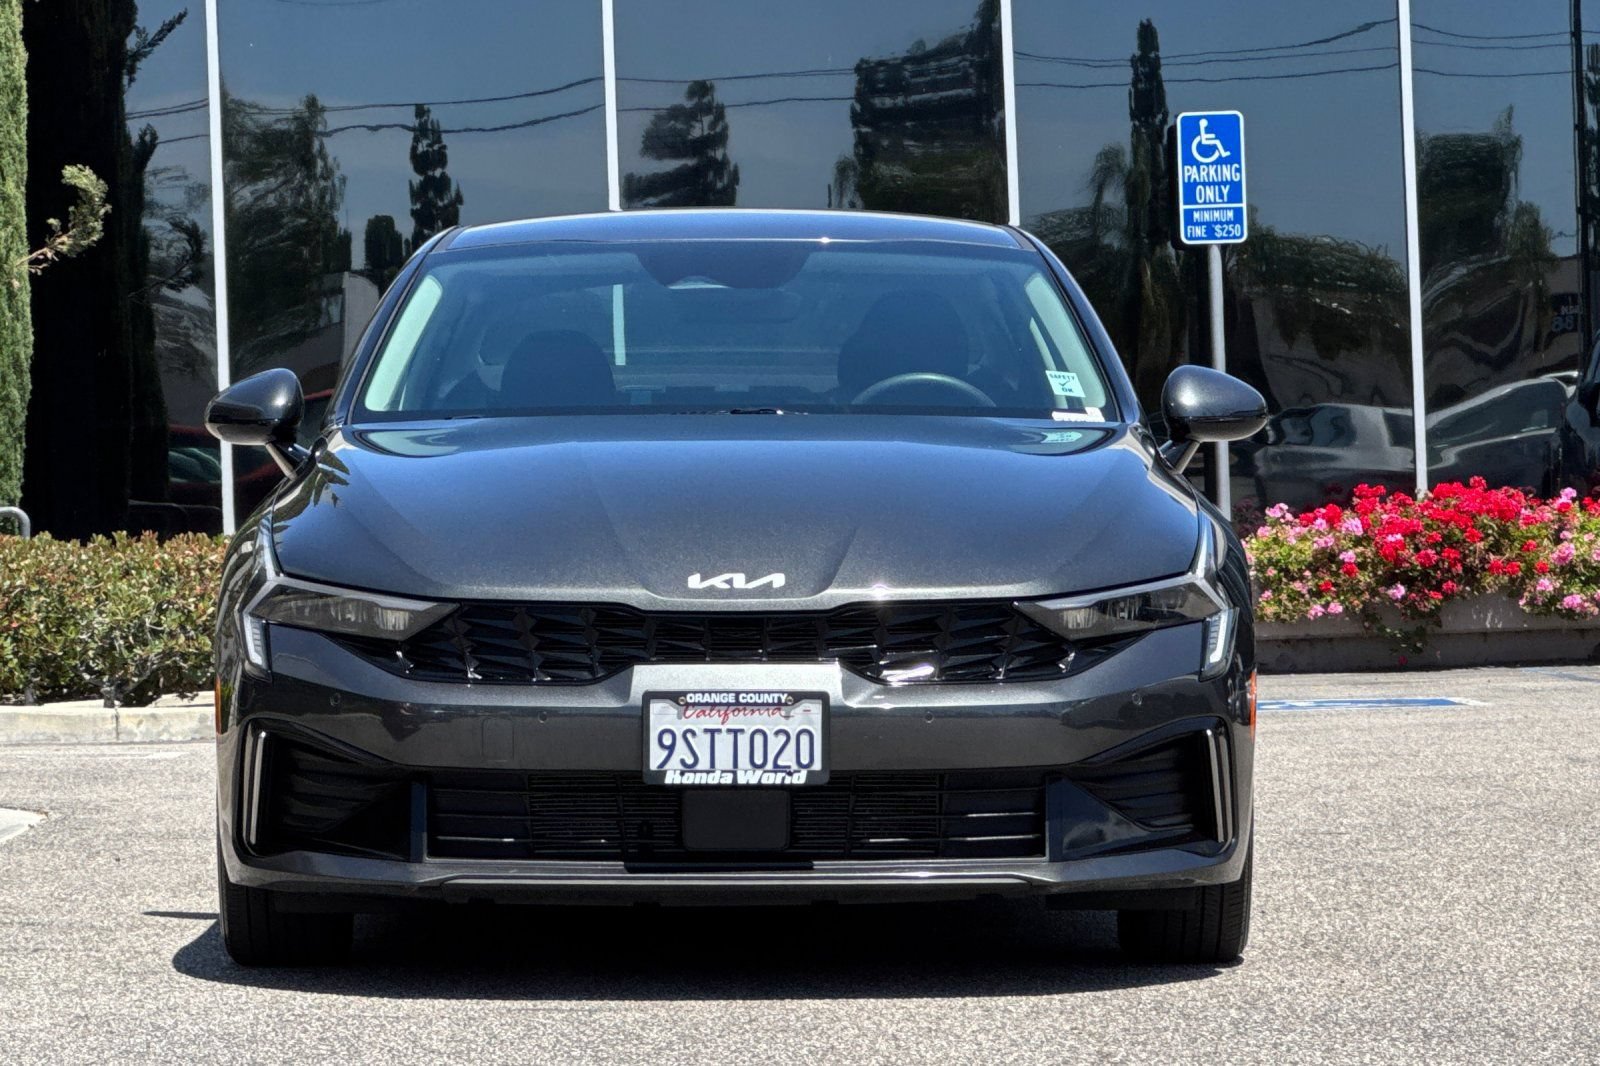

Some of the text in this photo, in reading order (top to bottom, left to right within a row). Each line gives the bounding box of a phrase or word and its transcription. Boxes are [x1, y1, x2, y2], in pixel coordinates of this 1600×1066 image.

[1184, 163, 1240, 183] PARKING
[1196, 185, 1230, 203] ONLY
[1193, 209, 1234, 222] MINIMUM
[1187, 223, 1241, 238] FINE $250
[686, 693, 788, 703] ORANGE COUNTY
[683, 705, 794, 725] California
[656, 728, 815, 769] 9STT020
[664, 770, 734, 785] Honda
